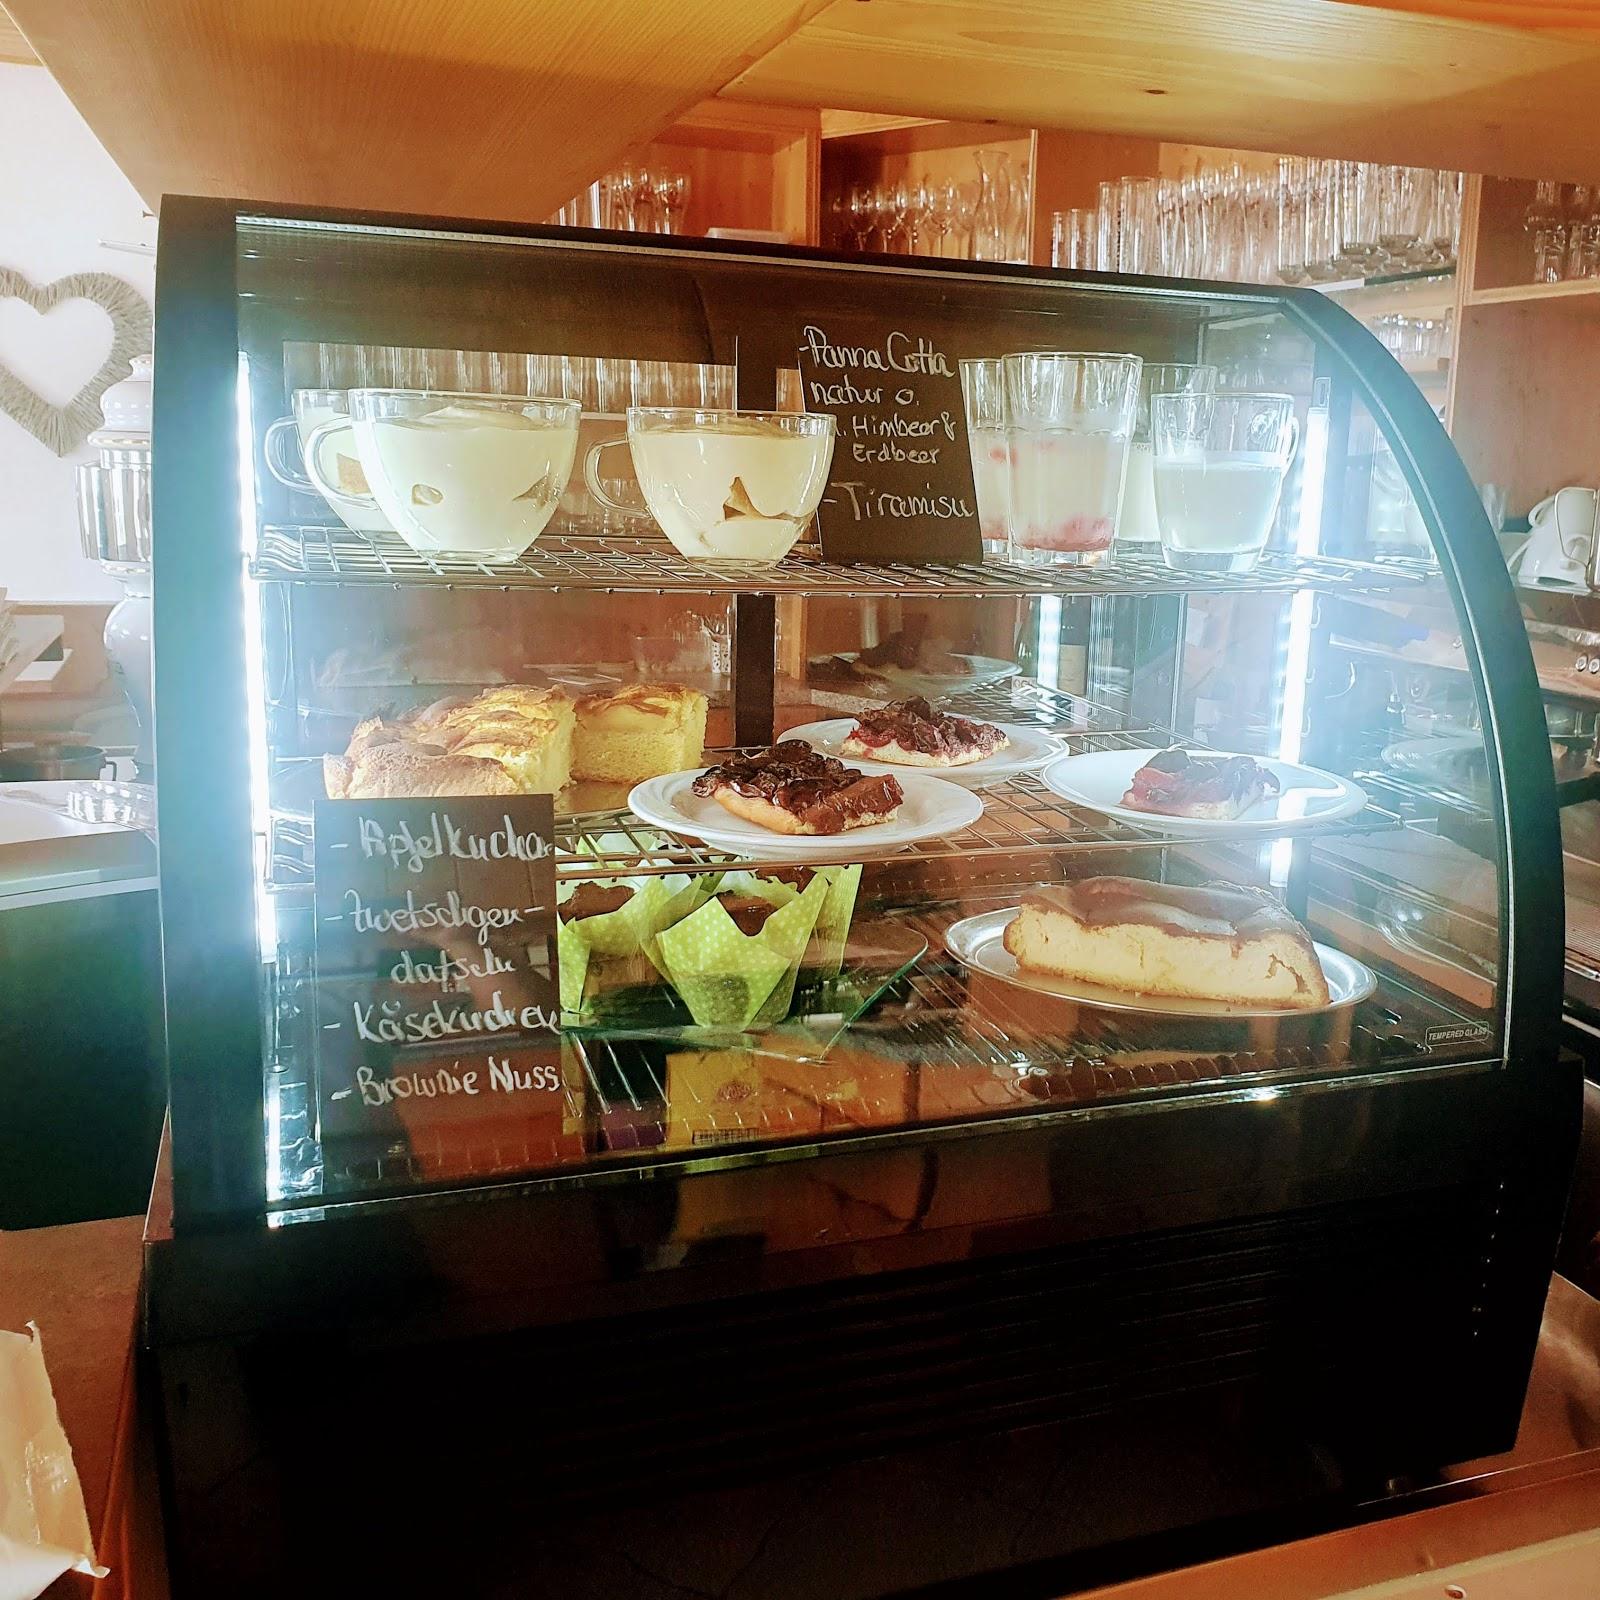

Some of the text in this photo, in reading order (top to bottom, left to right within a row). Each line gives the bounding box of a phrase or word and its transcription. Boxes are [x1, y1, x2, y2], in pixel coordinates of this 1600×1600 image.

[887, 332, 956, 377] Cotta
[810, 375, 883, 406] natur
[852, 413, 940, 438] Himbeer
[852, 443, 940, 464] Erdbeer
[831, 482, 975, 521] Tiramisu
[1428, 1027, 1488, 1041] TEMPERED GLASS
[356, 1061, 478, 1106] Brownie
[488, 1056, 561, 1095] Nuss
